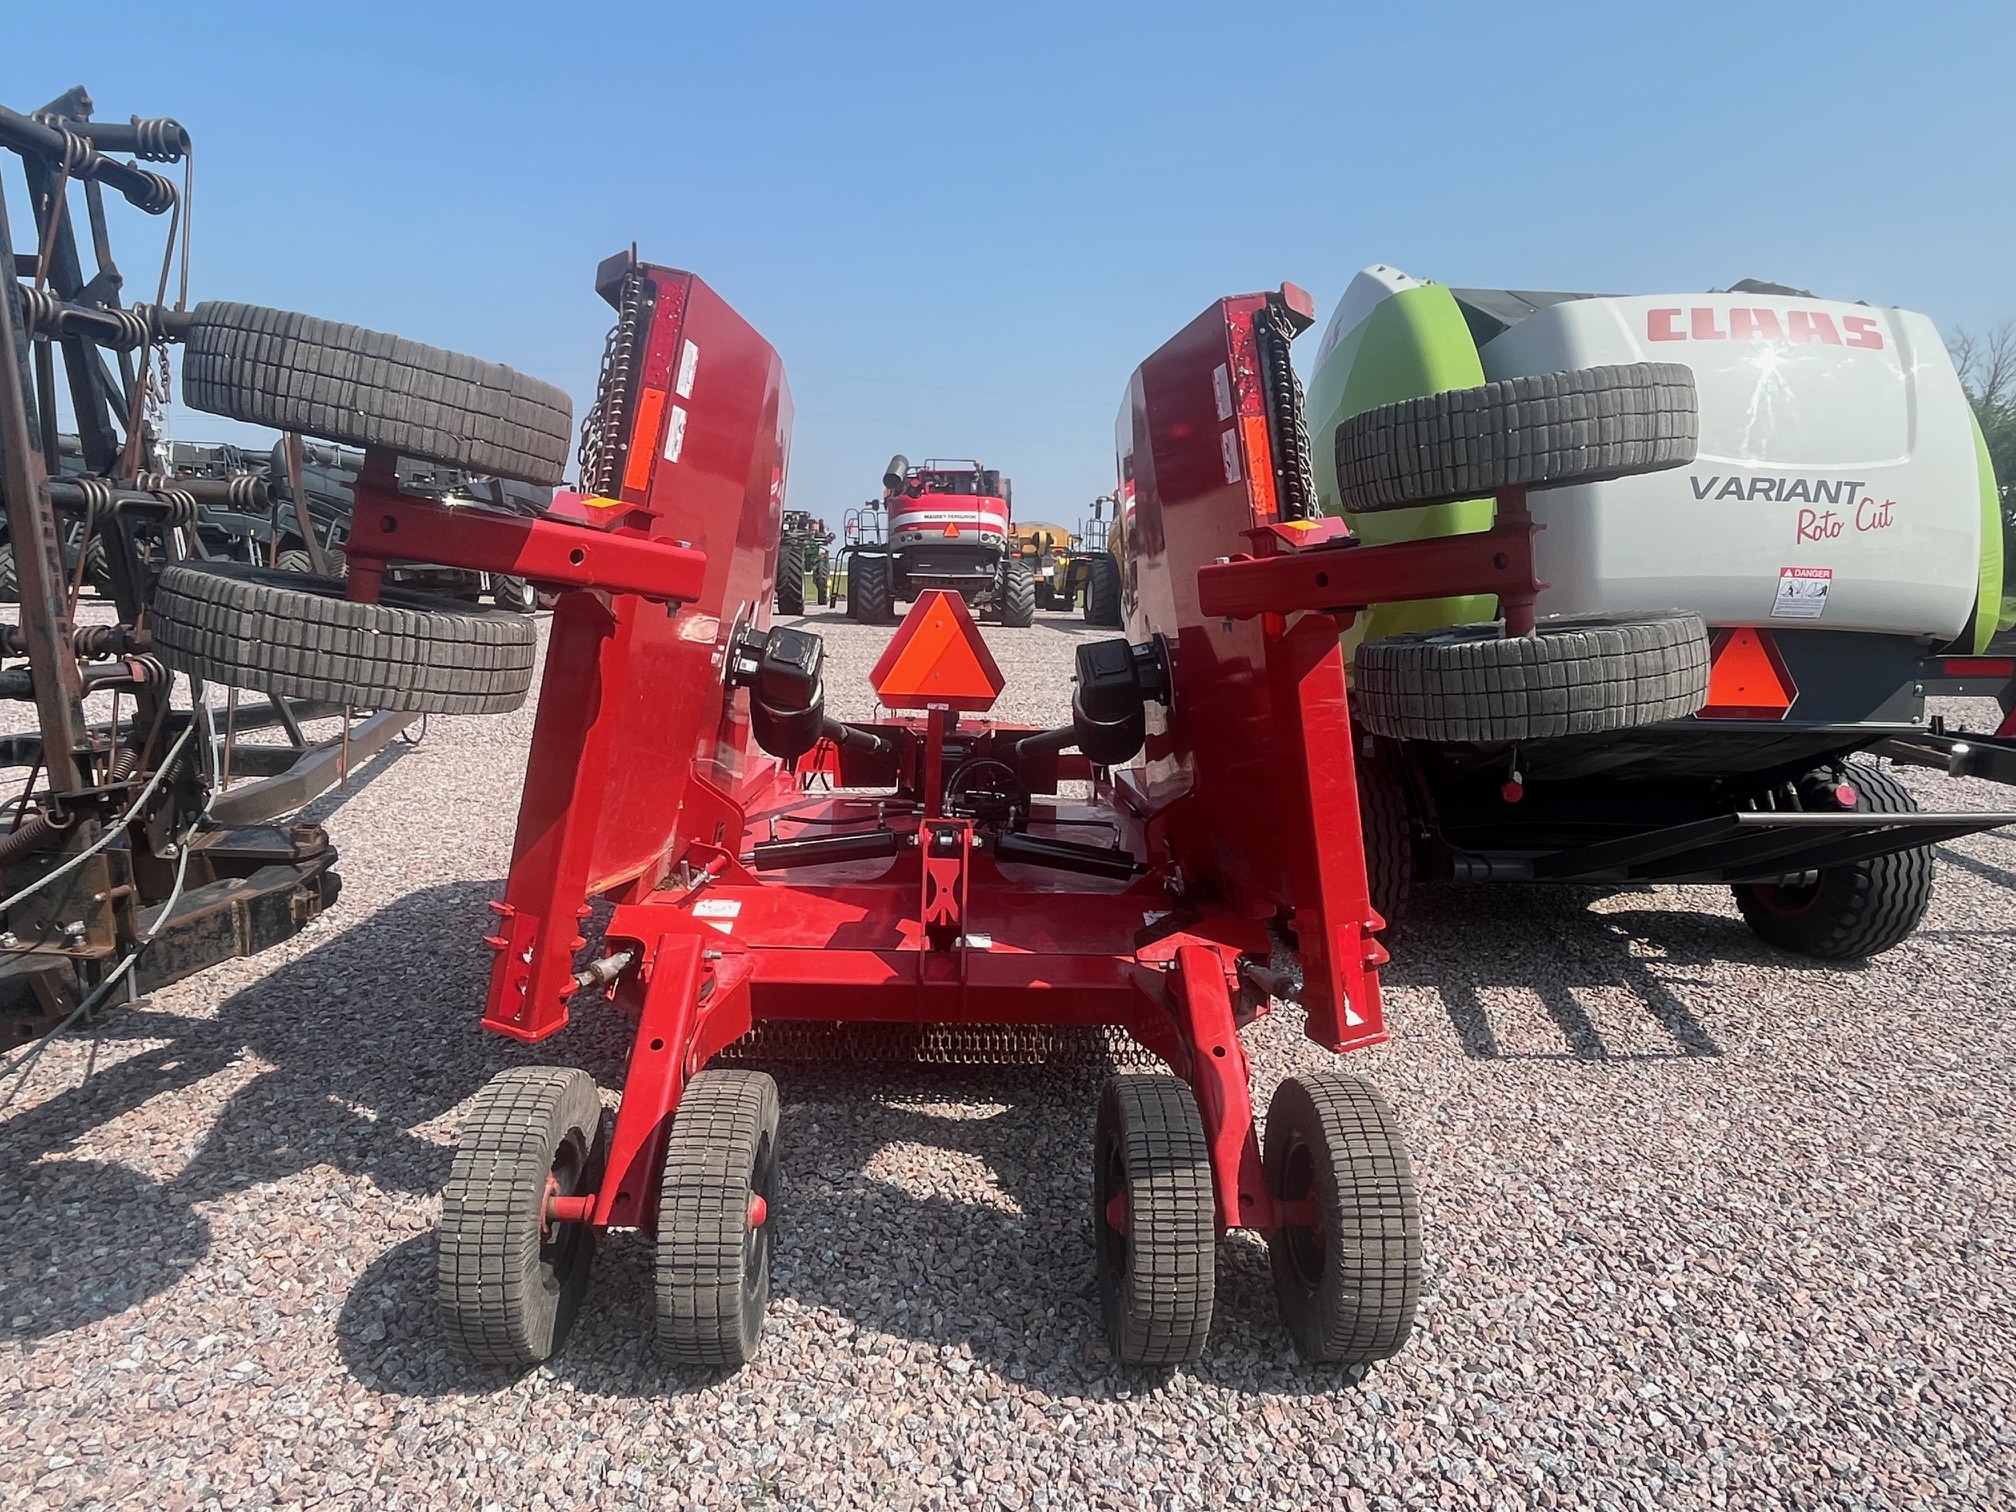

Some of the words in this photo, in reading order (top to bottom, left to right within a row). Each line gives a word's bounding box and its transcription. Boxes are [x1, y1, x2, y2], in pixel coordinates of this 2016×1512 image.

[1647, 308, 1884, 350] CLAAS
[1690, 476, 1865, 504] VARIANT
[1796, 508, 1845, 545] Roto
[1856, 497, 1897, 532] Cut
[1794, 569, 1831, 578] DANGER
